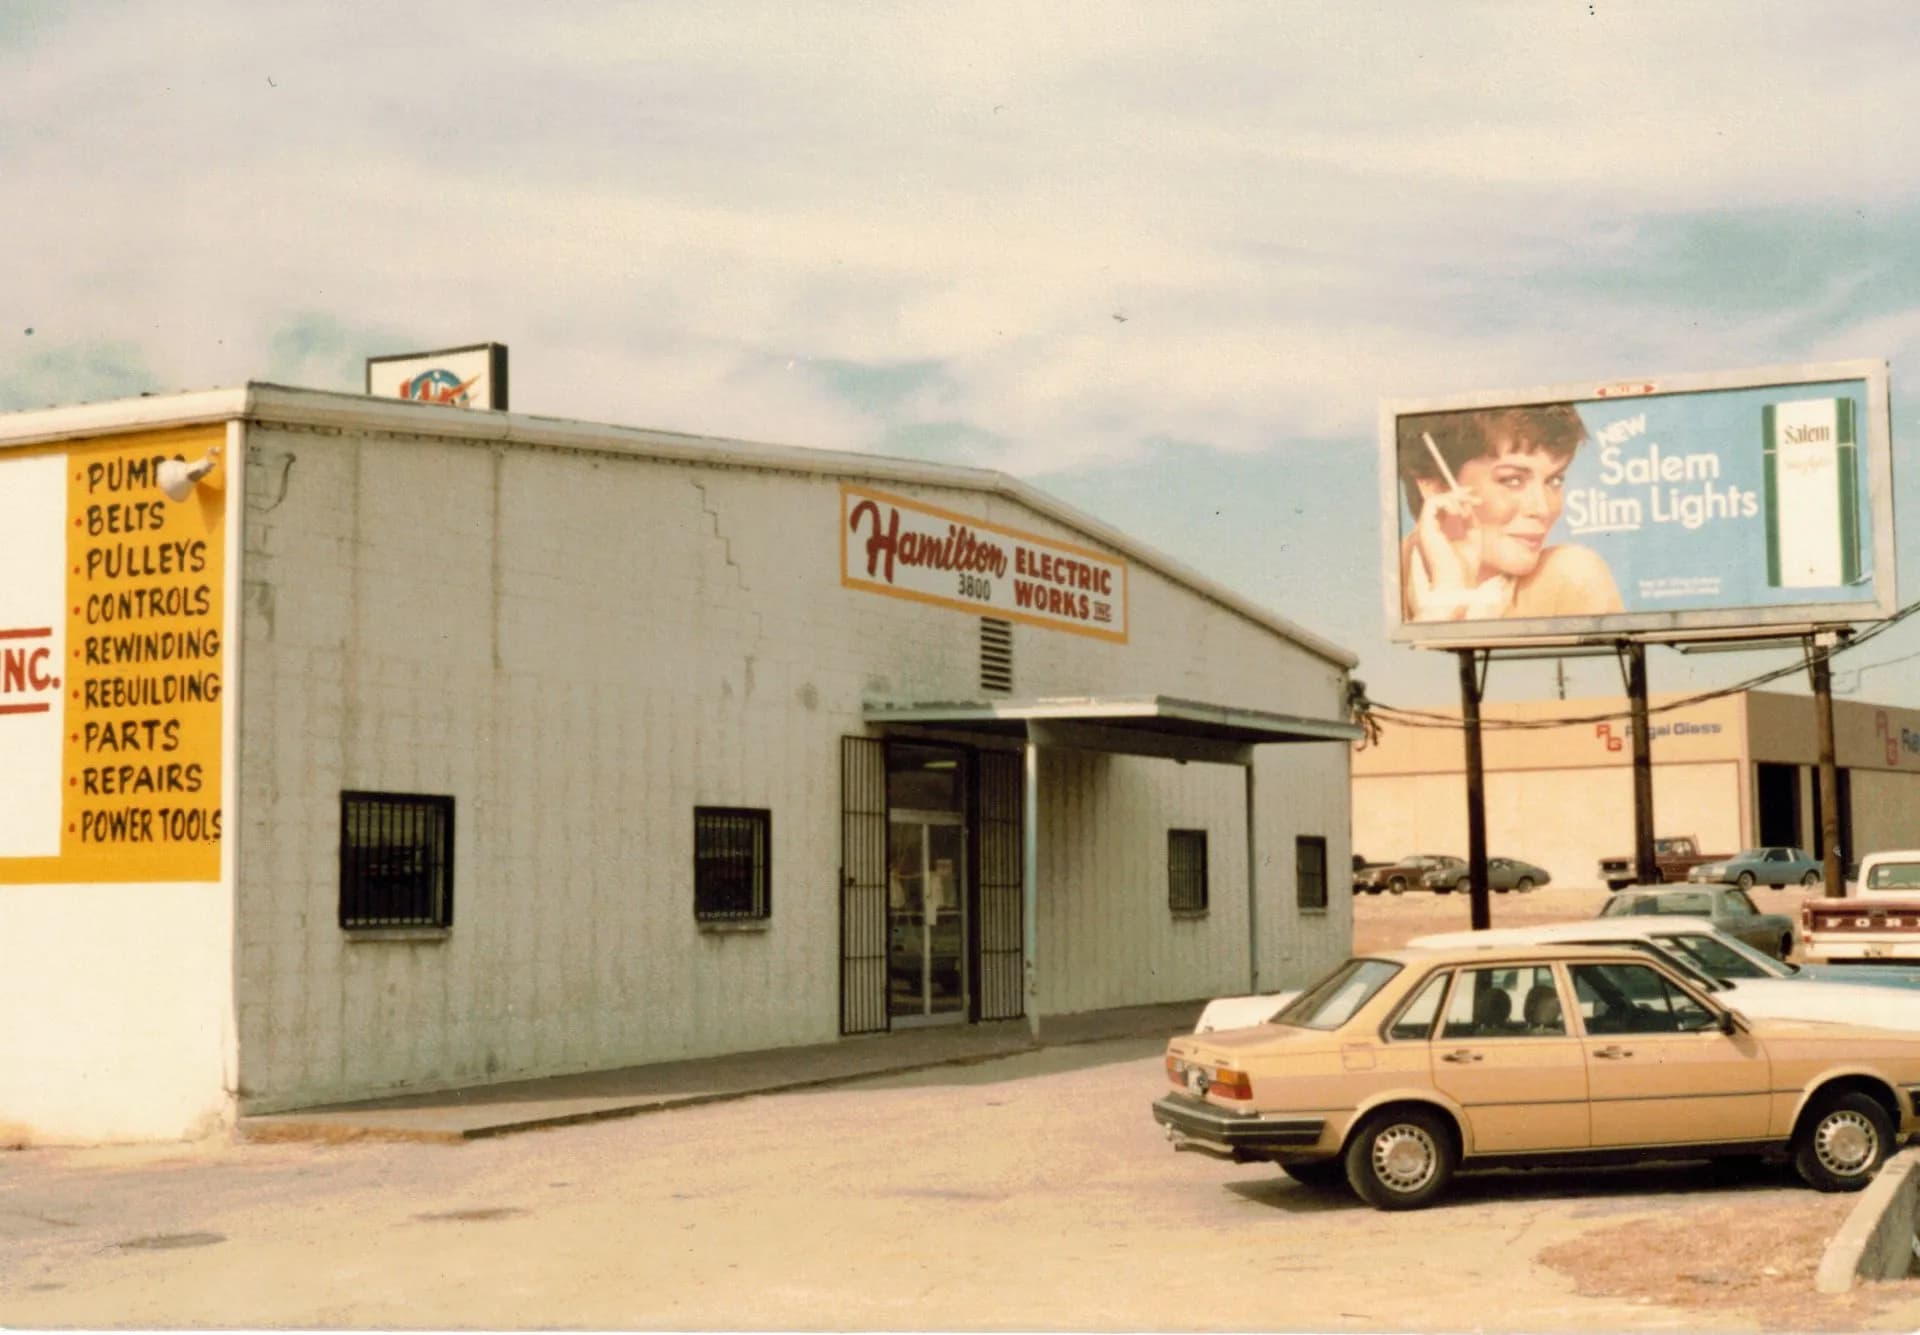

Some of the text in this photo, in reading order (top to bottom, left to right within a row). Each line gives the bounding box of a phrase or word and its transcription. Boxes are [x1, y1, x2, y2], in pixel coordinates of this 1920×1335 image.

[1600, 443, 1720, 486] Salem
[87, 501, 165, 537] BELTS
[1566, 481, 1759, 530] Slim Lights
[86, 540, 206, 580] PULLEYS
[850, 500, 1007, 584] Hamilton
[958, 574, 991, 602] 3800
[1014, 546, 1111, 596] ELECTRIC
[86, 584, 210, 625] CONTROLS
[1014, 579, 1090, 620] WORKS
[84, 629, 221, 667] REWINDING
[84, 672, 222, 710] REBUILDING
[84, 719, 181, 753] PARTS
[83, 764, 203, 795] REPAIRS
[81, 806, 222, 843] POWER TOOLS
